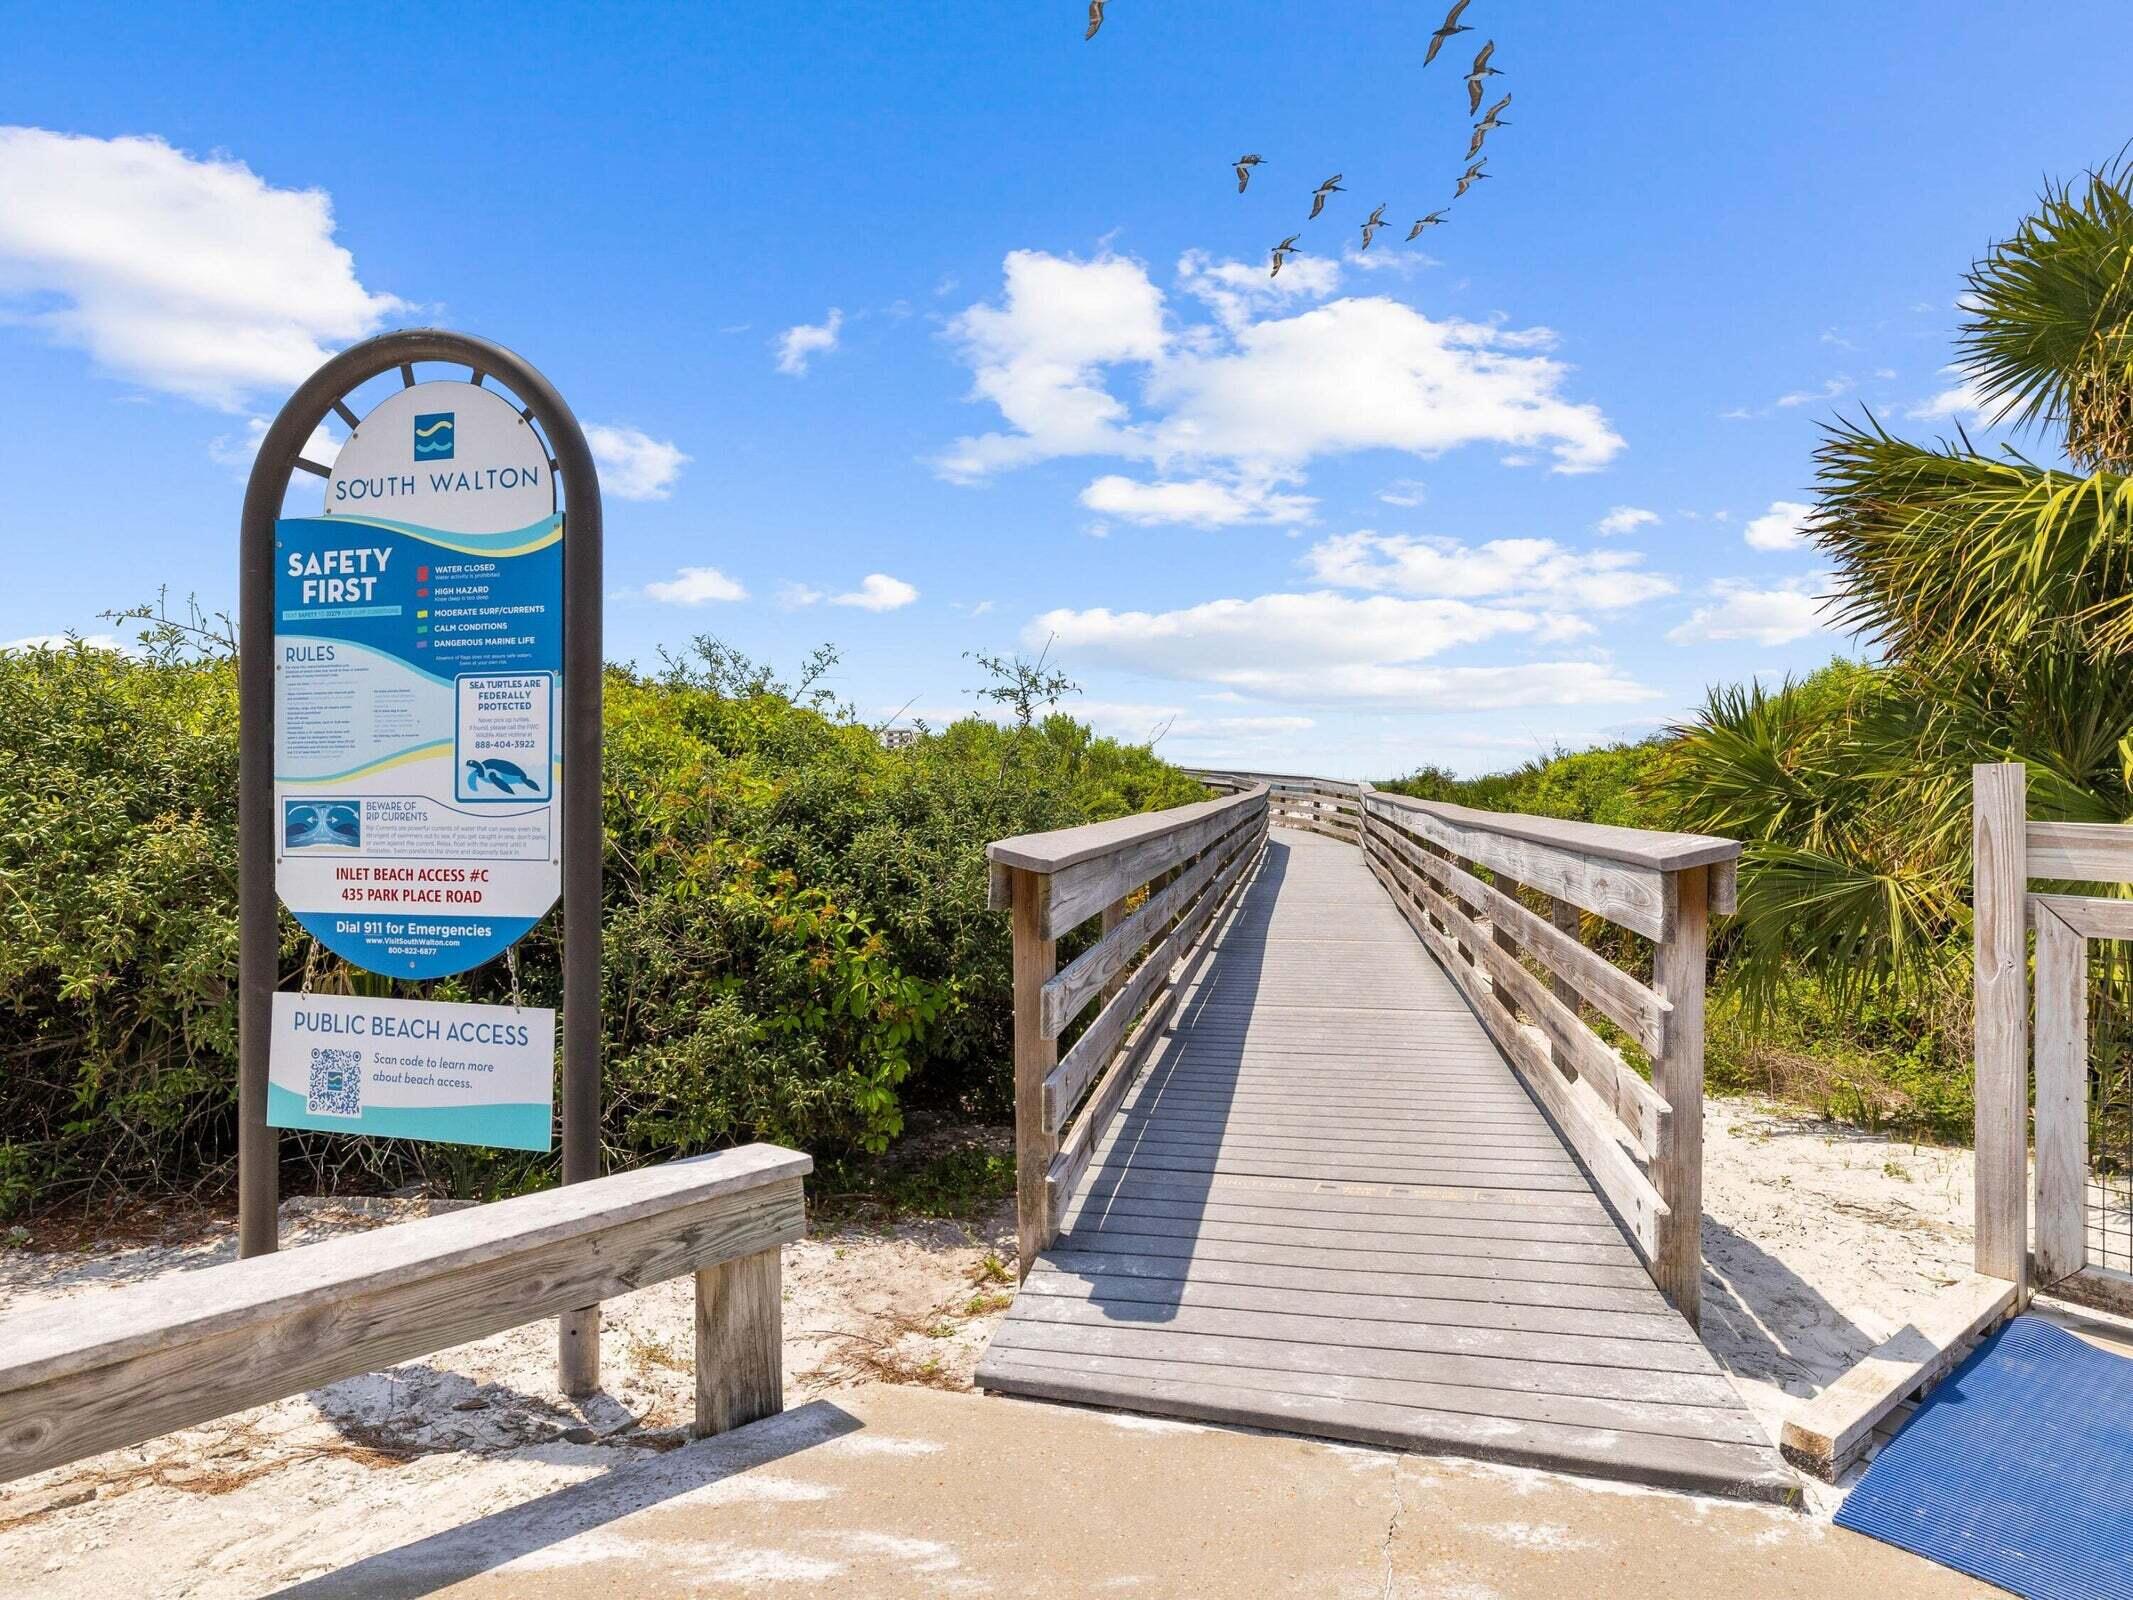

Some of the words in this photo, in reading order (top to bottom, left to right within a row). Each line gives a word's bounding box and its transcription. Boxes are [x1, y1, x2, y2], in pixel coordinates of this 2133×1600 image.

[336, 475, 415, 500] SOUTH
[430, 466, 538, 492] WALTON
[287, 547, 393, 577] SAFETY
[435, 565, 462, 574] WATER
[464, 563, 496, 572] CLOSED
[303, 576, 378, 604] FIRST
[434, 587, 454, 595] HIGH
[456, 586, 489, 594] HAZARD
[434, 607, 477, 617] MODERATE
[479, 605, 545, 615] SURF/CURRENTS
[434, 624, 457, 633] CALM
[458, 622, 508, 631] CONDITIONS
[434, 638, 483, 648] DANGEROUS
[485, 637, 516, 645] MARINE
[518, 636, 536, 644] LIFE
[286, 646, 335, 662] RULES
[469, 681, 485, 689] SEA
[486, 680, 522, 689] TURTLES
[524, 679, 541, 688] ARE
[479, 690, 531, 700] FEDERALLY
[478, 702, 532, 711] PROTECTED
[475, 740, 535, 749] 888-404-3922
[366, 801, 402, 811] BEWARE
[403, 801, 416, 810] OF
[366, 812, 380, 821] RIP
[381, 812, 428, 821] CURRENTS
[336, 868, 369, 880] INLET
[374, 868, 413, 881] BEACH
[418, 869, 465, 882] ACCESS
[470, 869, 489, 882] #C
[342, 888, 363, 901] 435
[368, 888, 398, 901] PARK
[403, 889, 441, 902] PLACE
[446, 890, 482, 903] ROAD
[336, 921, 360, 933] Dial
[364, 922, 382, 934] 911
[386, 922, 404, 934] for
[408, 923, 492, 937] Emergencies
[366, 937, 460, 947] www.VisitSouthWalton.com
[388, 947, 437, 955] 800-822-6877
[294, 1011, 365, 1034] PUBLIC
[371, 1016, 441, 1040] BEACH
[446, 1021, 529, 1046] ACCESS
[373, 1052, 397, 1065] Scan
[400, 1055, 424, 1067] code
[427, 1056, 437, 1068] to
[440, 1057, 465, 1070] learn
[468, 1063, 494, 1073] more
[373, 1070, 402, 1083] about
[404, 1072, 435, 1086] beach
[437, 1078, 473, 1089] access.
